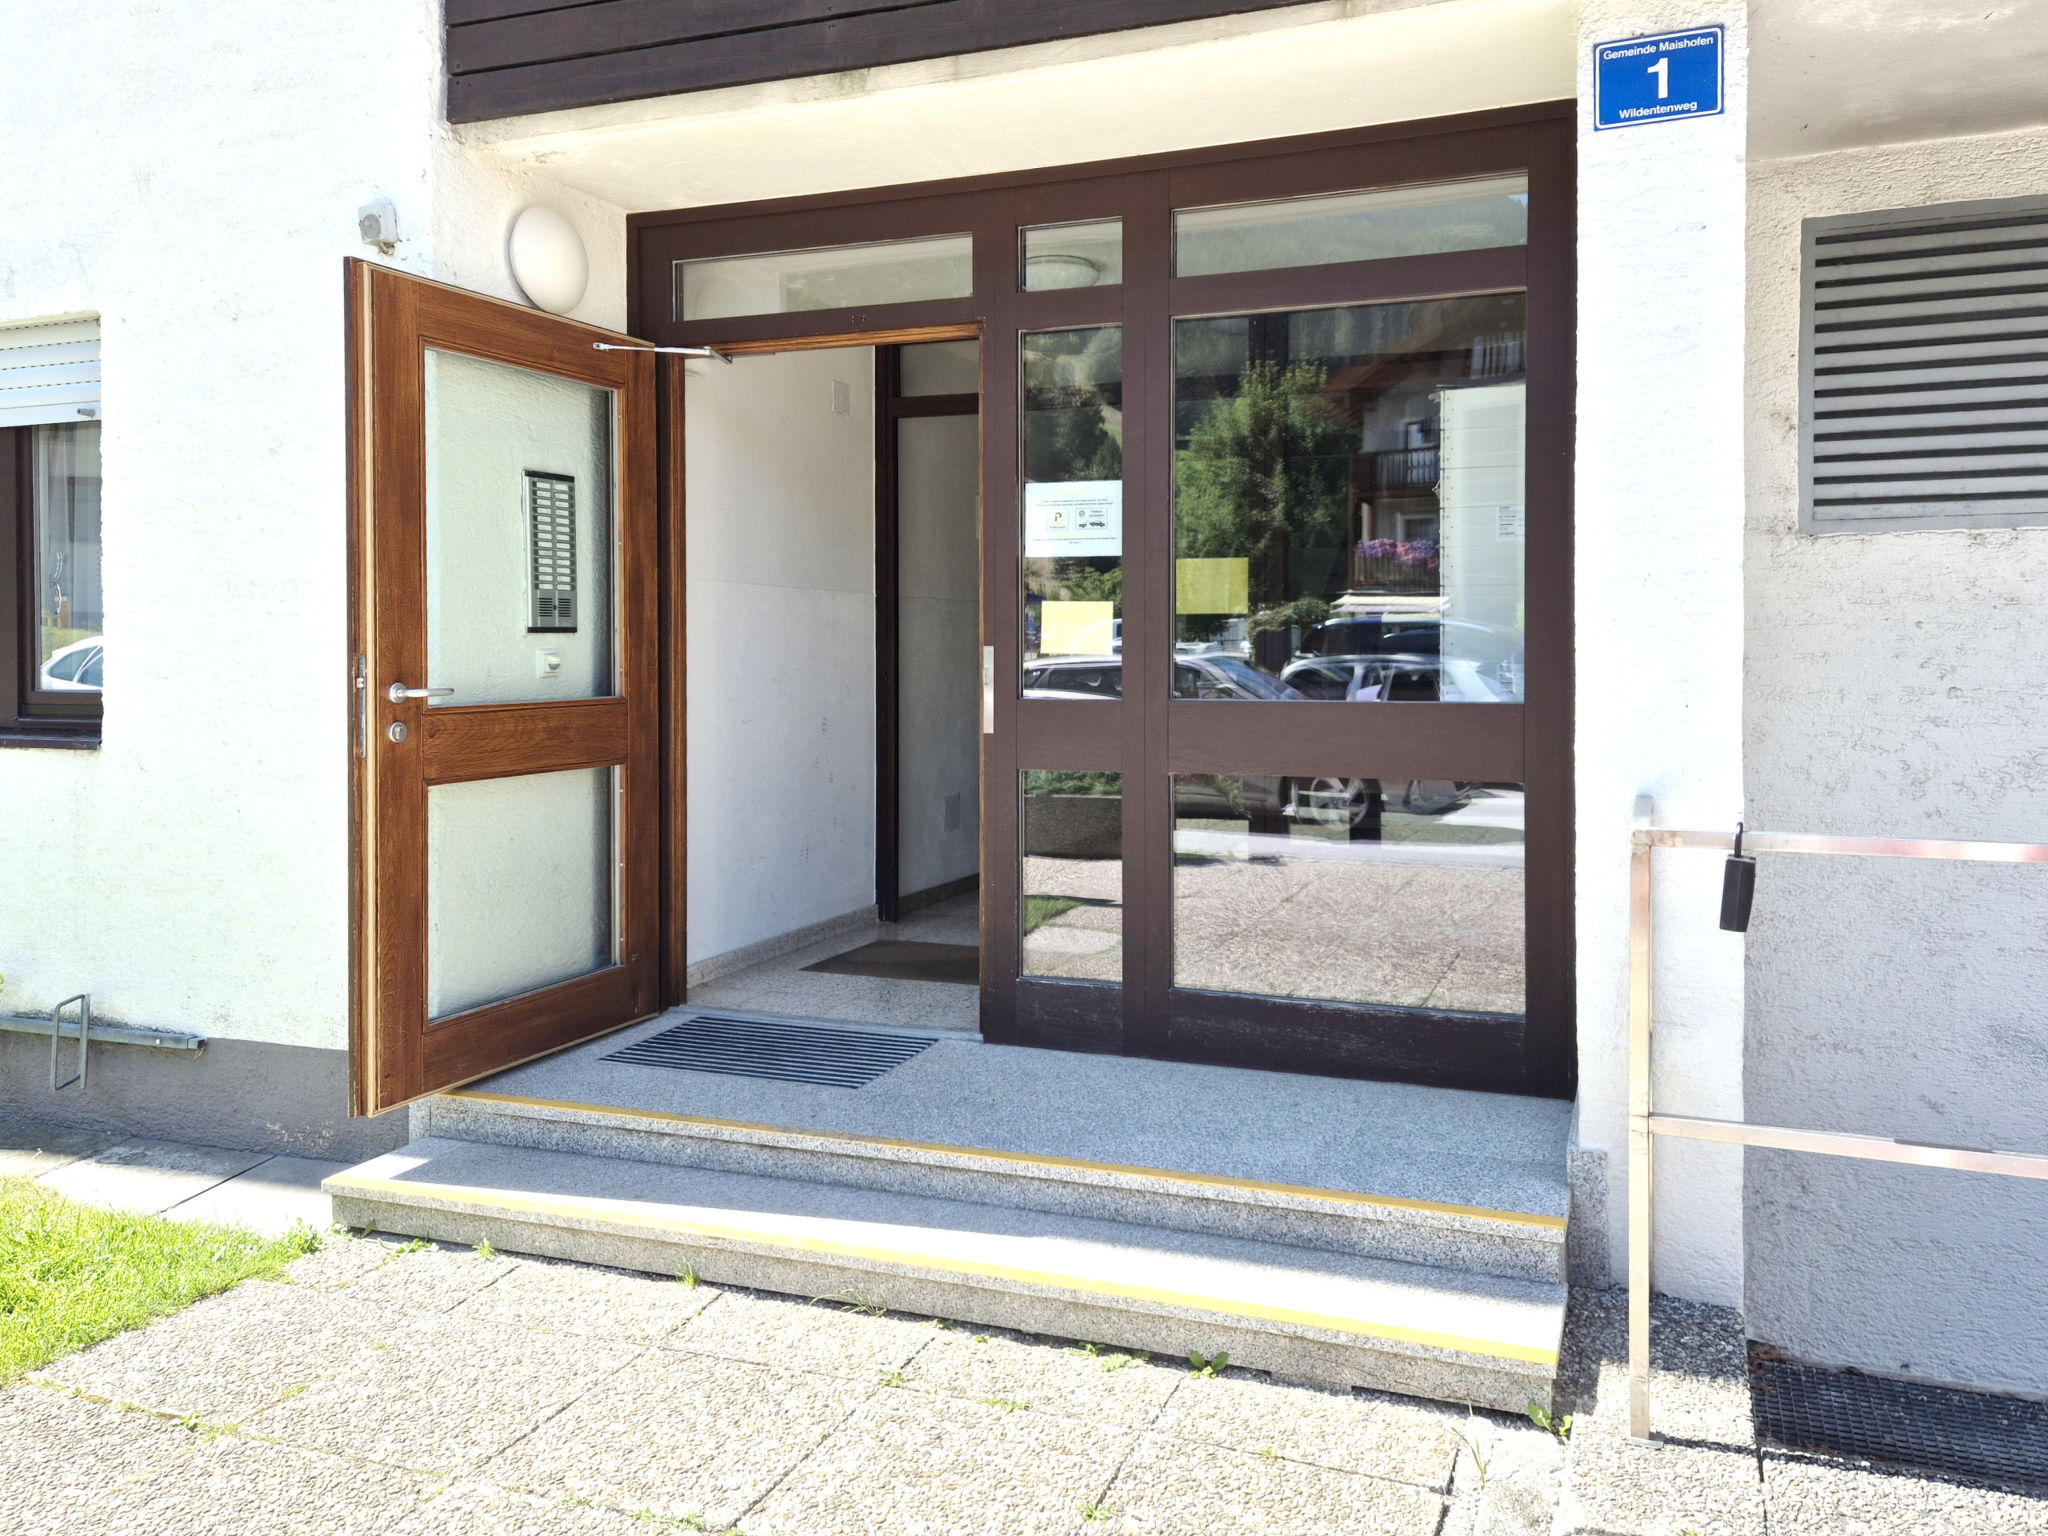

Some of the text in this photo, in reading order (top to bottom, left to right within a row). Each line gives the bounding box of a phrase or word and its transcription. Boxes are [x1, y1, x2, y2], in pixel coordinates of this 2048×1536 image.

[1603, 37, 1714, 60] Gemeinde Maishofen
[1647, 57, 1669, 99] 1
[1619, 101, 1697, 119] Wildentenweg
